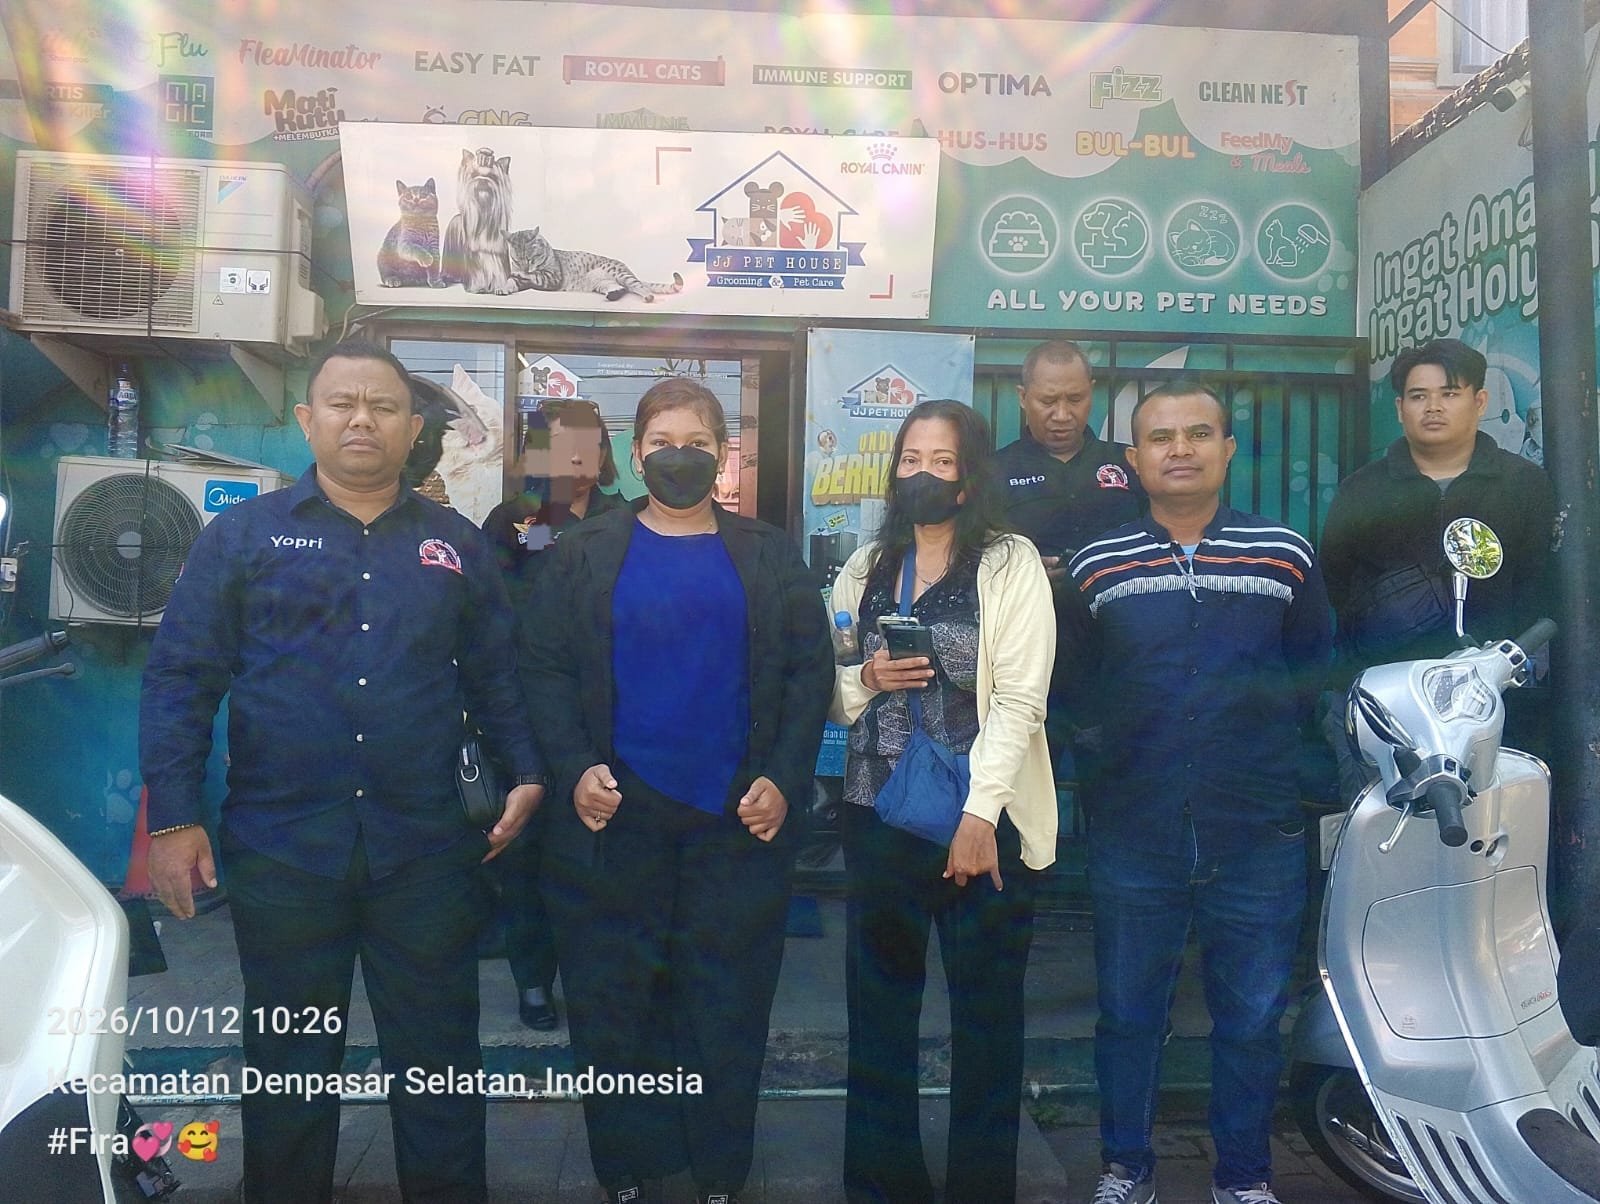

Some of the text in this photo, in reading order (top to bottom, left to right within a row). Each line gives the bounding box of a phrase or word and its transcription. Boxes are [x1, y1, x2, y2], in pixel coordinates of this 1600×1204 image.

[239, 39, 382, 69] FleaMinator
[414, 50, 541, 76] EASY FAT
[585, 61, 702, 81] ROYAL CATS
[758, 68, 907, 87] IMMUNE SUPPORT
[938, 71, 1052, 97] OPTIMA
[1199, 80, 1308, 106] CLEAN NEST
[264, 87, 338, 115] Mati
[274, 108, 346, 132] Kutu
[938, 129, 1048, 151] HUS-HUS
[1075, 130, 1196, 159] BUL-BUL
[1220, 131, 1293, 154] FeedMy
[840, 162, 923, 176] ROYAL CANIN
[712, 255, 842, 270] JJ PET HOUSE
[1374, 211, 1458, 307] Ingat
[716, 276, 834, 287] Grooming & Pet Care
[987, 288, 1327, 316] ALL YOUR PET NEEDS
[1369, 277, 1451, 364] Ingat
[852, 408, 866, 416] JJ
[868, 408, 889, 417] PET
[1009, 474, 1046, 486] Berto
[270, 535, 323, 549] Yopri
